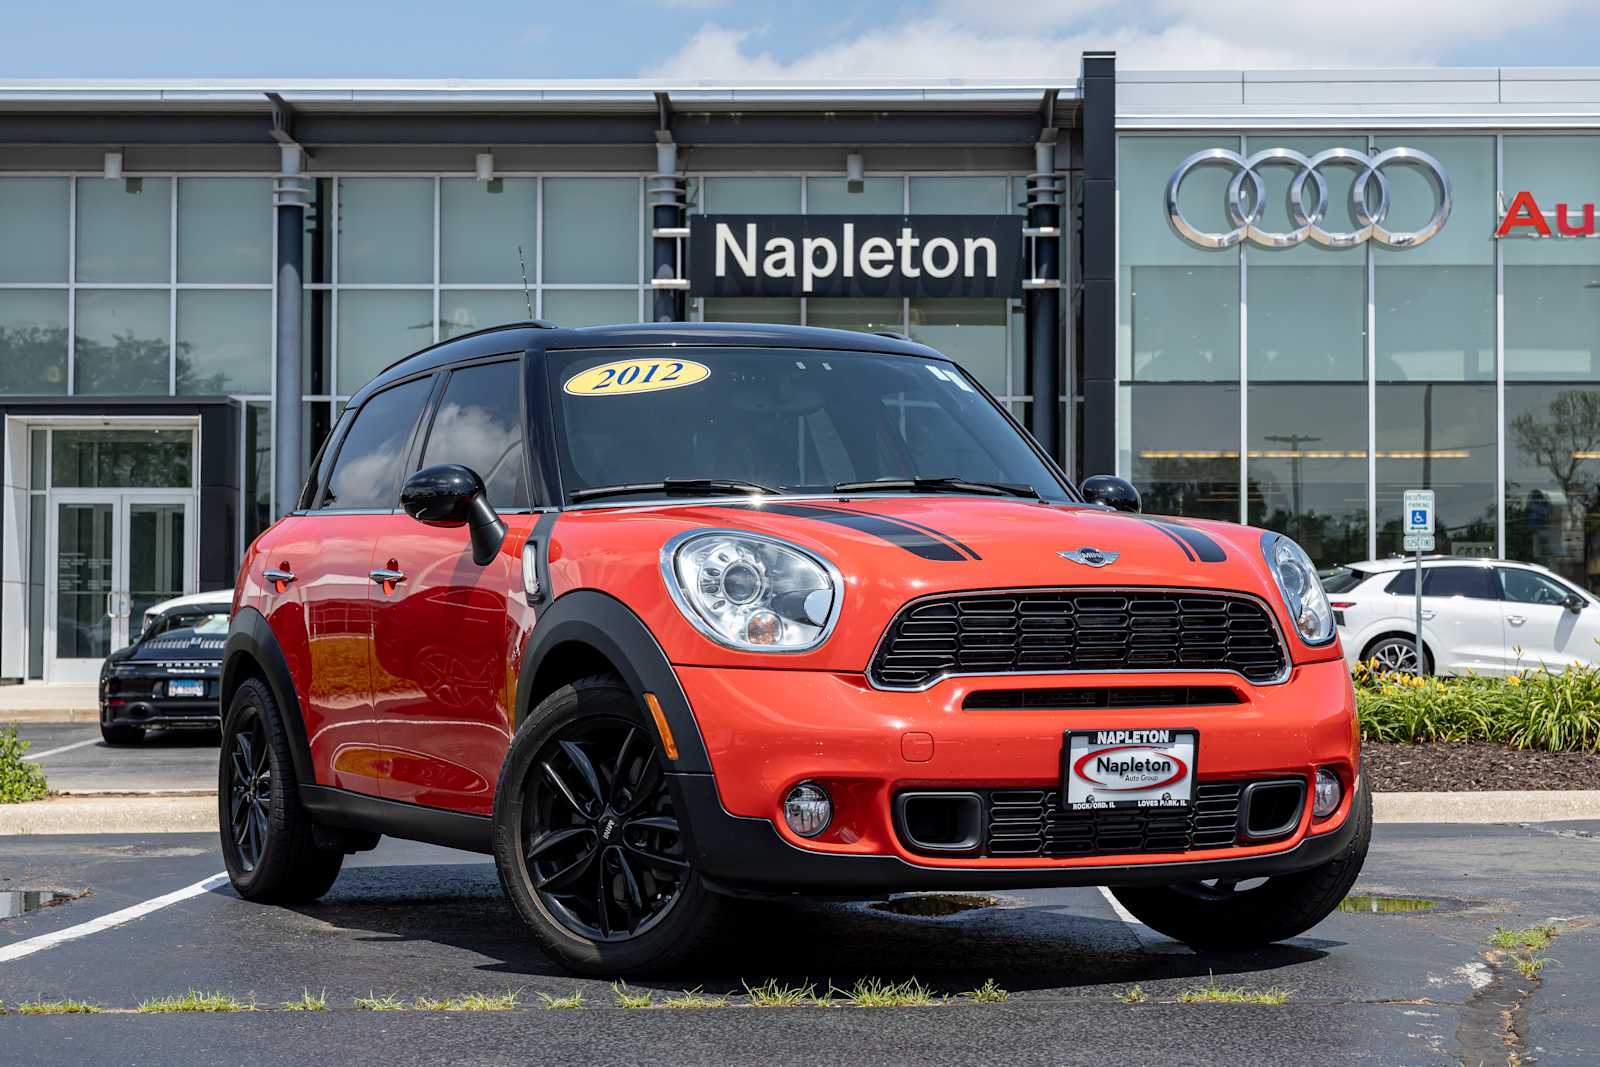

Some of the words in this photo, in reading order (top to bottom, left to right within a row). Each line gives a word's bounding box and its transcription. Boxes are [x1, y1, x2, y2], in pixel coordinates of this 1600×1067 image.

[1495, 190, 1595, 238] Au
[715, 223, 998, 292] Napleton
[591, 362, 684, 391] 2012
[1097, 730, 1170, 744] NAPLETON
[1097, 757, 1172, 776] Napleton
[1141, 774, 1159, 782] Group
[1180, 799, 1187, 807] IL
